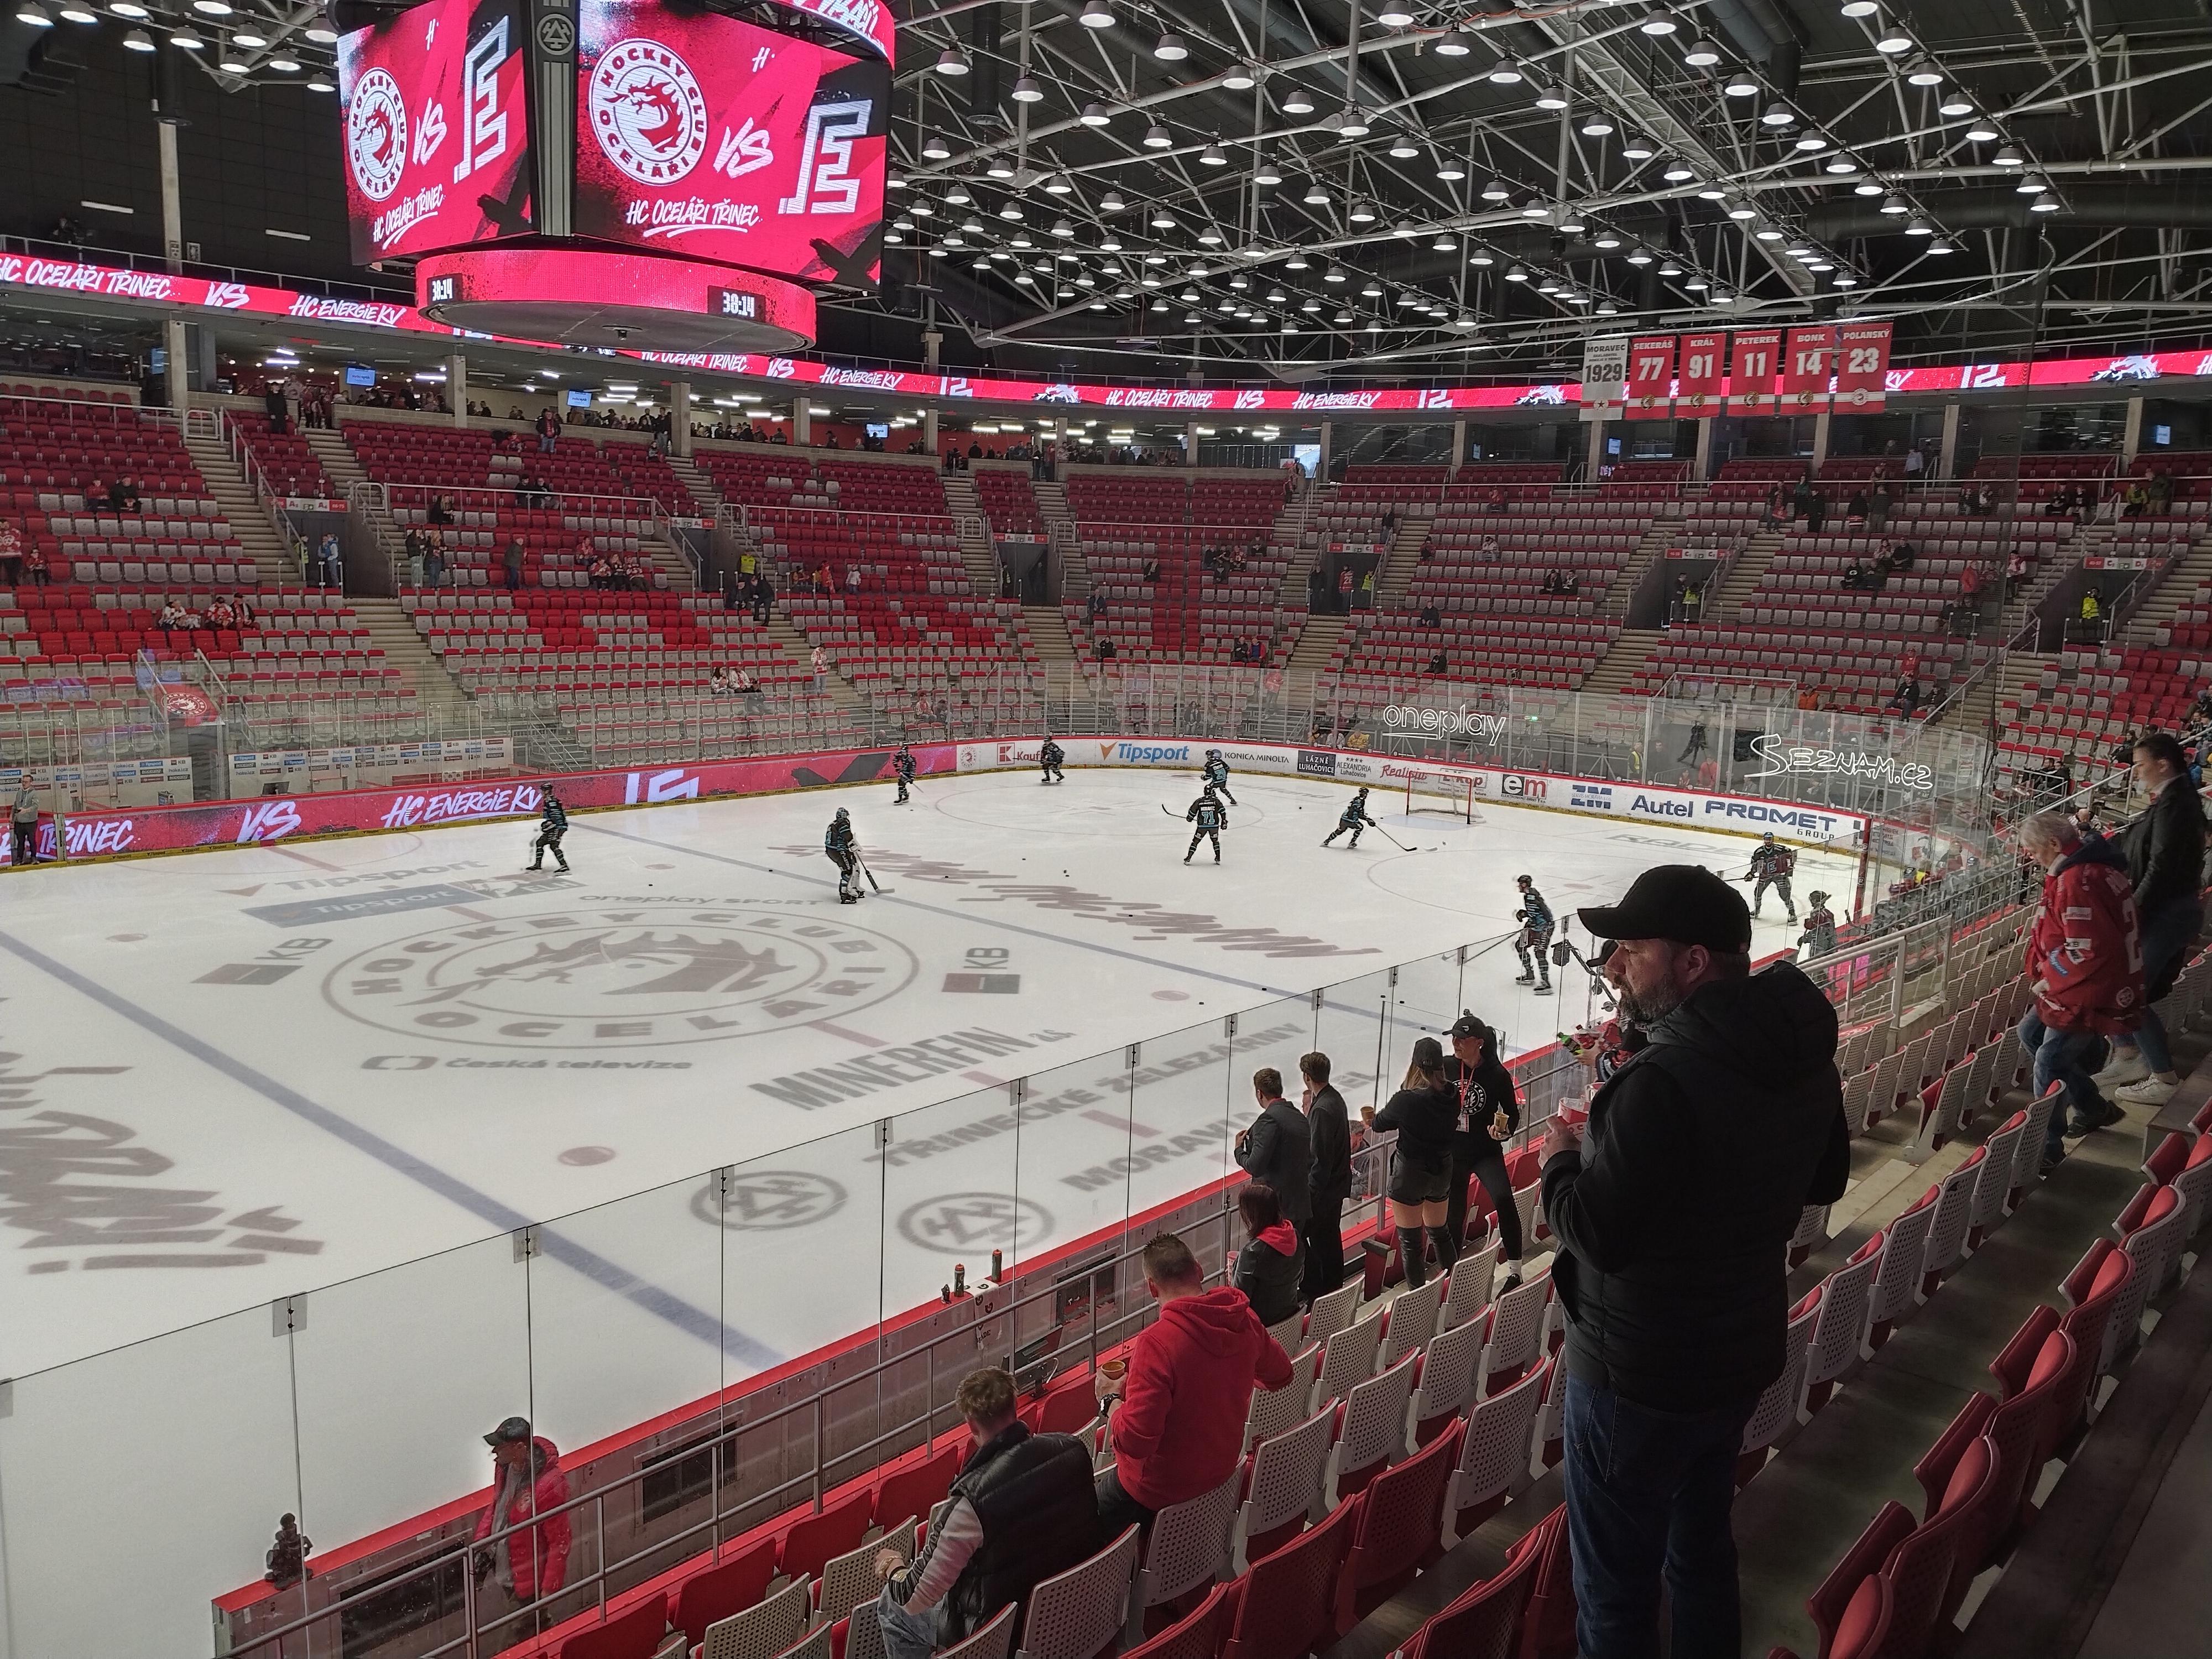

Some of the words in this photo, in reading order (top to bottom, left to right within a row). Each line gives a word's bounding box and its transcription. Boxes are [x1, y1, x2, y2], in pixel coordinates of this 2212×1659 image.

[601, 48, 686, 87] HOCKEY
[688, 86, 702, 153] CLUB
[353, 75, 392, 127] HOCKEY
[393, 93, 405, 152] CLUB
[412, 97, 447, 166] VS
[599, 109, 689, 178] OCELÁŘI
[713, 117, 774, 179] VS
[373, 215, 384, 243] HC
[385, 191, 414, 234] OCELÁŘI
[415, 184, 444, 218] TŘINEC
[626, 200, 650, 225] HC
[653, 196, 707, 225] OCELÁŘI
[712, 198, 760, 226] TŘINEC
[25, 260, 104, 291] OCELÁŘI
[106, 270, 171, 299] TŘINEC
[204, 281, 249, 308] VS
[722, 291, 755, 318] 38:14
[289, 295, 318, 317] HC
[377, 304, 407, 326] KV
[1634, 340, 1673, 349] SEKERÁŠ
[1691, 338, 1714, 347] KRÁL
[1735, 336, 1778, 345] PETEREK
[1797, 333, 1825, 342] BONK
[765, 358, 794, 378] VS
[1637, 357, 1665, 381] 77
[1688, 354, 1714, 379] 91
[1745, 352, 1767, 377] 11
[1796, 351, 1823, 375] 14
[1848, 347, 1880, 374] 23
[819, 367, 839, 383] HC
[881, 373, 904, 389] KV
[1585, 363, 1623, 383] 1929
[1885, 371, 1913, 387] KV
[1105, 389, 1123, 405] HC
[1125, 389, 1168, 406] OCELÁŘI
[1172, 390, 1213, 408] TŘINEC
[1233, 390, 1265, 409] VS
[1292, 393, 1313, 409] HC
[1357, 392, 1382, 407] KV
[1383, 704, 1506, 746] oneplay
[1118, 743, 1189, 763] Tipsport
[1224, 752, 1254, 760] KONICA
[1256, 754, 1290, 763] MINOLTA
[1306, 755, 1329, 764] LÁZNĚ
[1299, 763, 1334, 774] LUHAČOVICE
[1337, 762, 1371, 772] ALEXANDRIA
[1340, 769, 1366, 778] Luhačovice
[380, 795, 425, 828] HC
[509, 785, 542, 812] KV
[1201, 811, 1215, 823] 71
[1631, 795, 1693, 817] Autel
[1705, 800, 1837, 831] PROMET
[236, 801, 301, 843] VS
[1797, 830, 1834, 841] GROUP
[274, 860, 490, 891] Tipsport
[311, 890, 458, 915] Tipsport
[579, 894, 718, 905] oneplay
[254, 938, 333, 961] KB
[352, 912, 648, 997] HOCKEY
[691, 913, 878, 954] CLUB
[963, 946, 1010, 969] KB
[413, 967, 886, 1038] OCELÁŘI
[445, 1057, 549, 1068] česká
[556, 1060, 693, 1070] televize
[747, 1026, 1040, 1110] MINERFIN
[862, 1088, 1105, 1167] TŘINECKÉ
[1095, 1022, 1308, 1093] ŽELEZÁRNY
